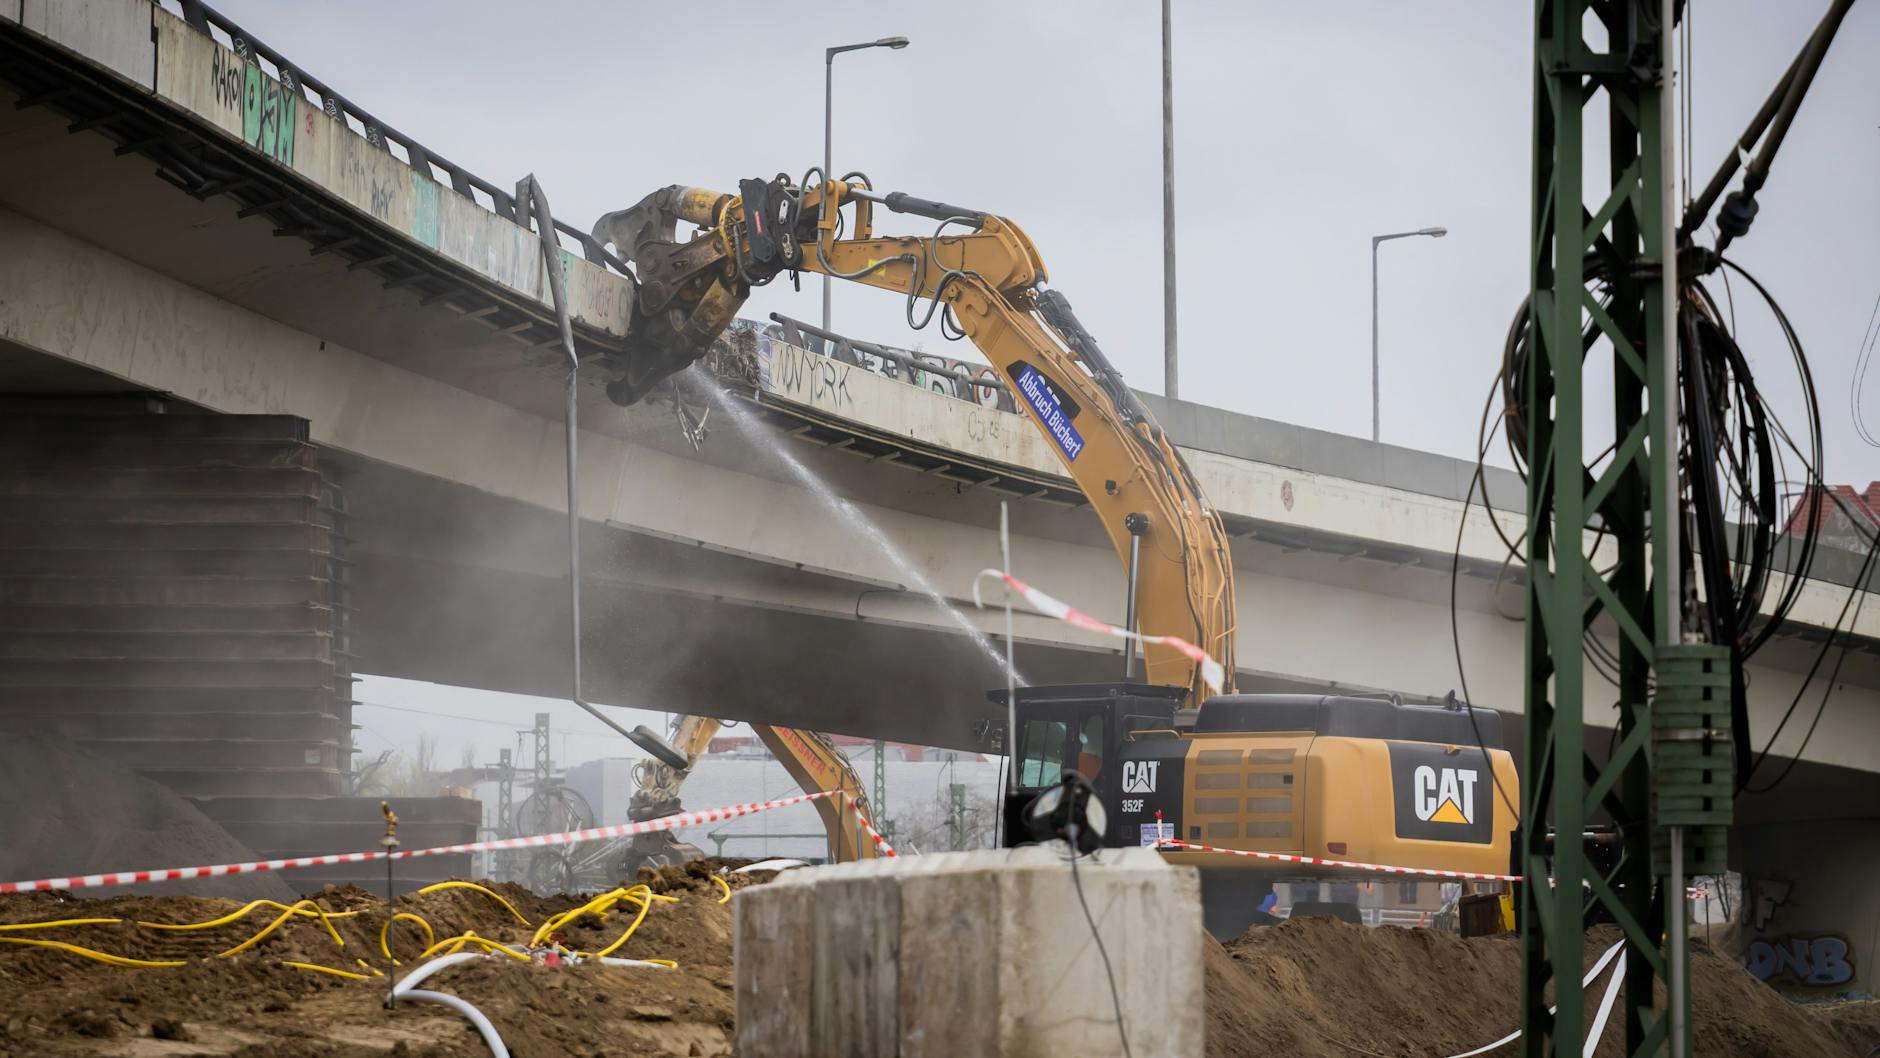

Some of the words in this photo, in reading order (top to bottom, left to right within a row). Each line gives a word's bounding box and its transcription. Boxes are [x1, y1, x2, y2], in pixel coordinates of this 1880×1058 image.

[1019, 371, 1053, 419] Abbruch
[1048, 409, 1081, 458] Büchert
[1122, 760, 1160, 794] CAT
[1414, 765, 1478, 825] CAT
[1121, 799, 1145, 813] 352F
[1745, 935, 1856, 987] DNB
